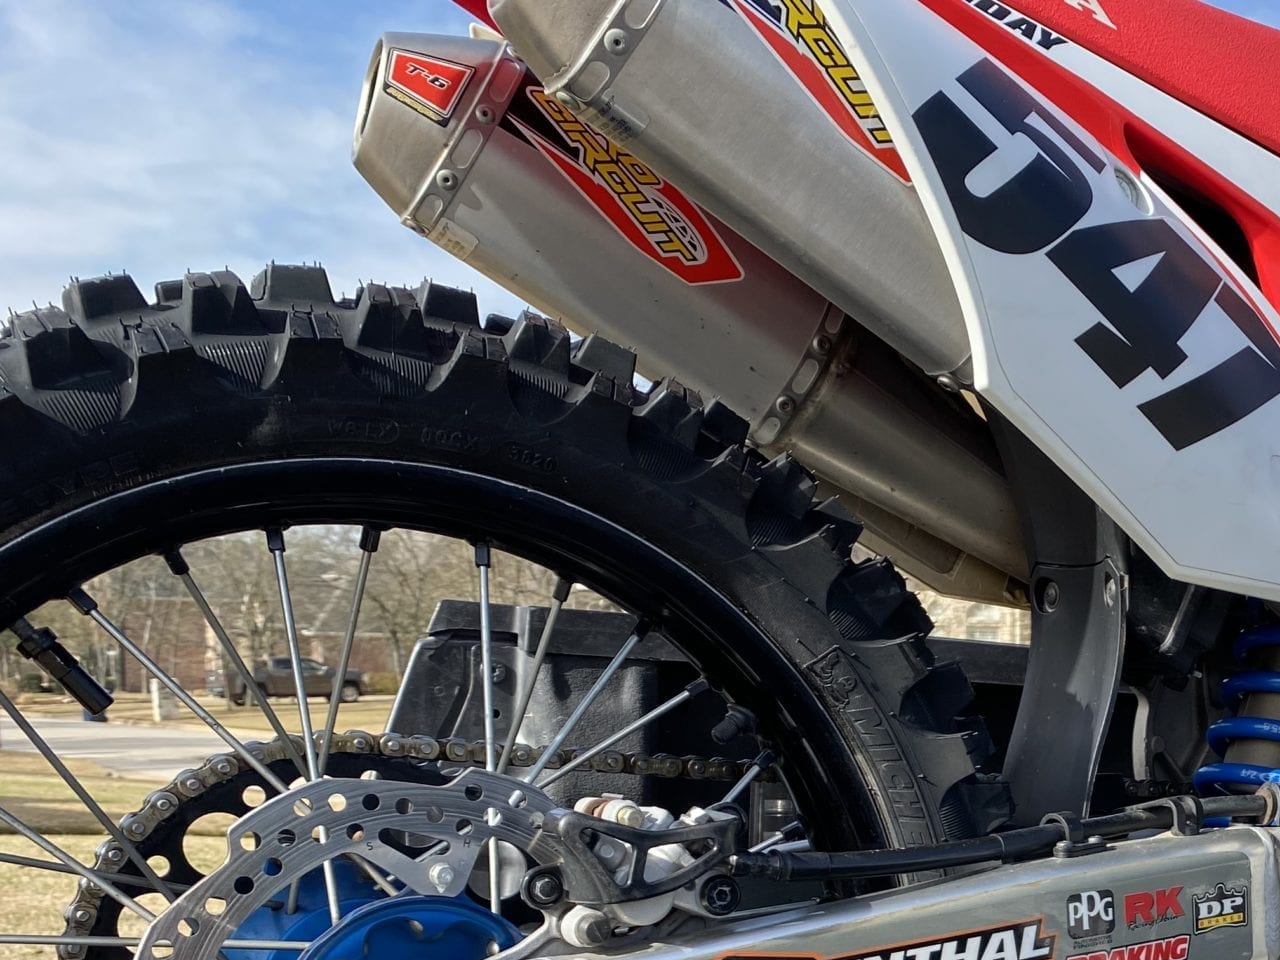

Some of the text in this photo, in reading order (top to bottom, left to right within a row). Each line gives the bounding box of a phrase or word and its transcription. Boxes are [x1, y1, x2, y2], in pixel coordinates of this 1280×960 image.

[967, 0, 1069, 50] DAY
[405, 62, 452, 90] T-6
[531, 89, 698, 262] CIRCUIT
[844, 705, 933, 848] MICHE
[1068, 890, 1114, 931] PPG
[1124, 886, 1185, 925] RK
[1198, 897, 1243, 919] DP
